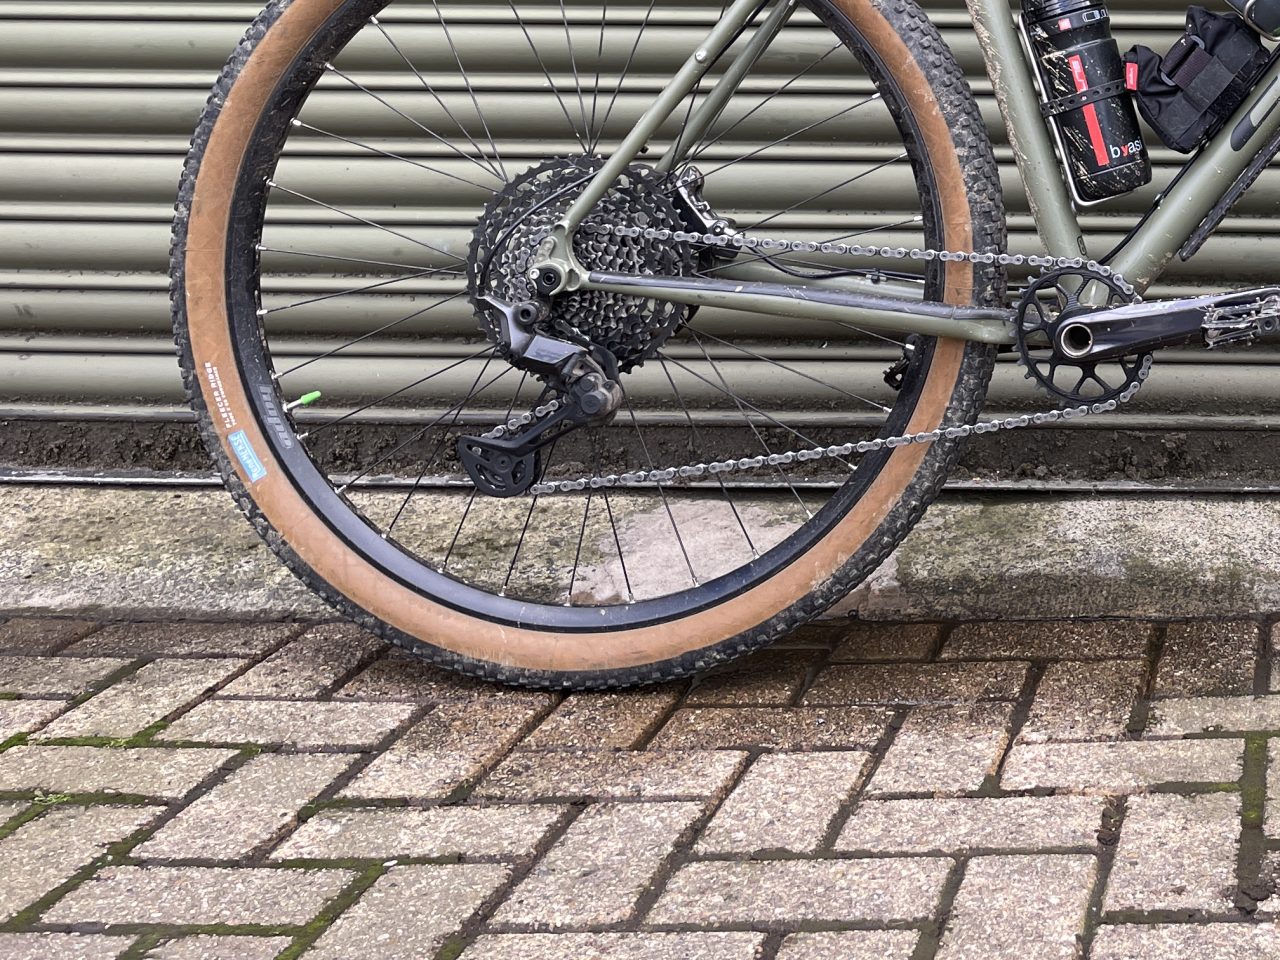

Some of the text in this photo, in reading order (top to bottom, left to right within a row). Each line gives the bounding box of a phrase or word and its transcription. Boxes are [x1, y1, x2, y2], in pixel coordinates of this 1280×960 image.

[204, 361, 219, 390] RIDGE
[213, 390, 231, 428] FLEECER
[258, 384, 294, 449] hope
